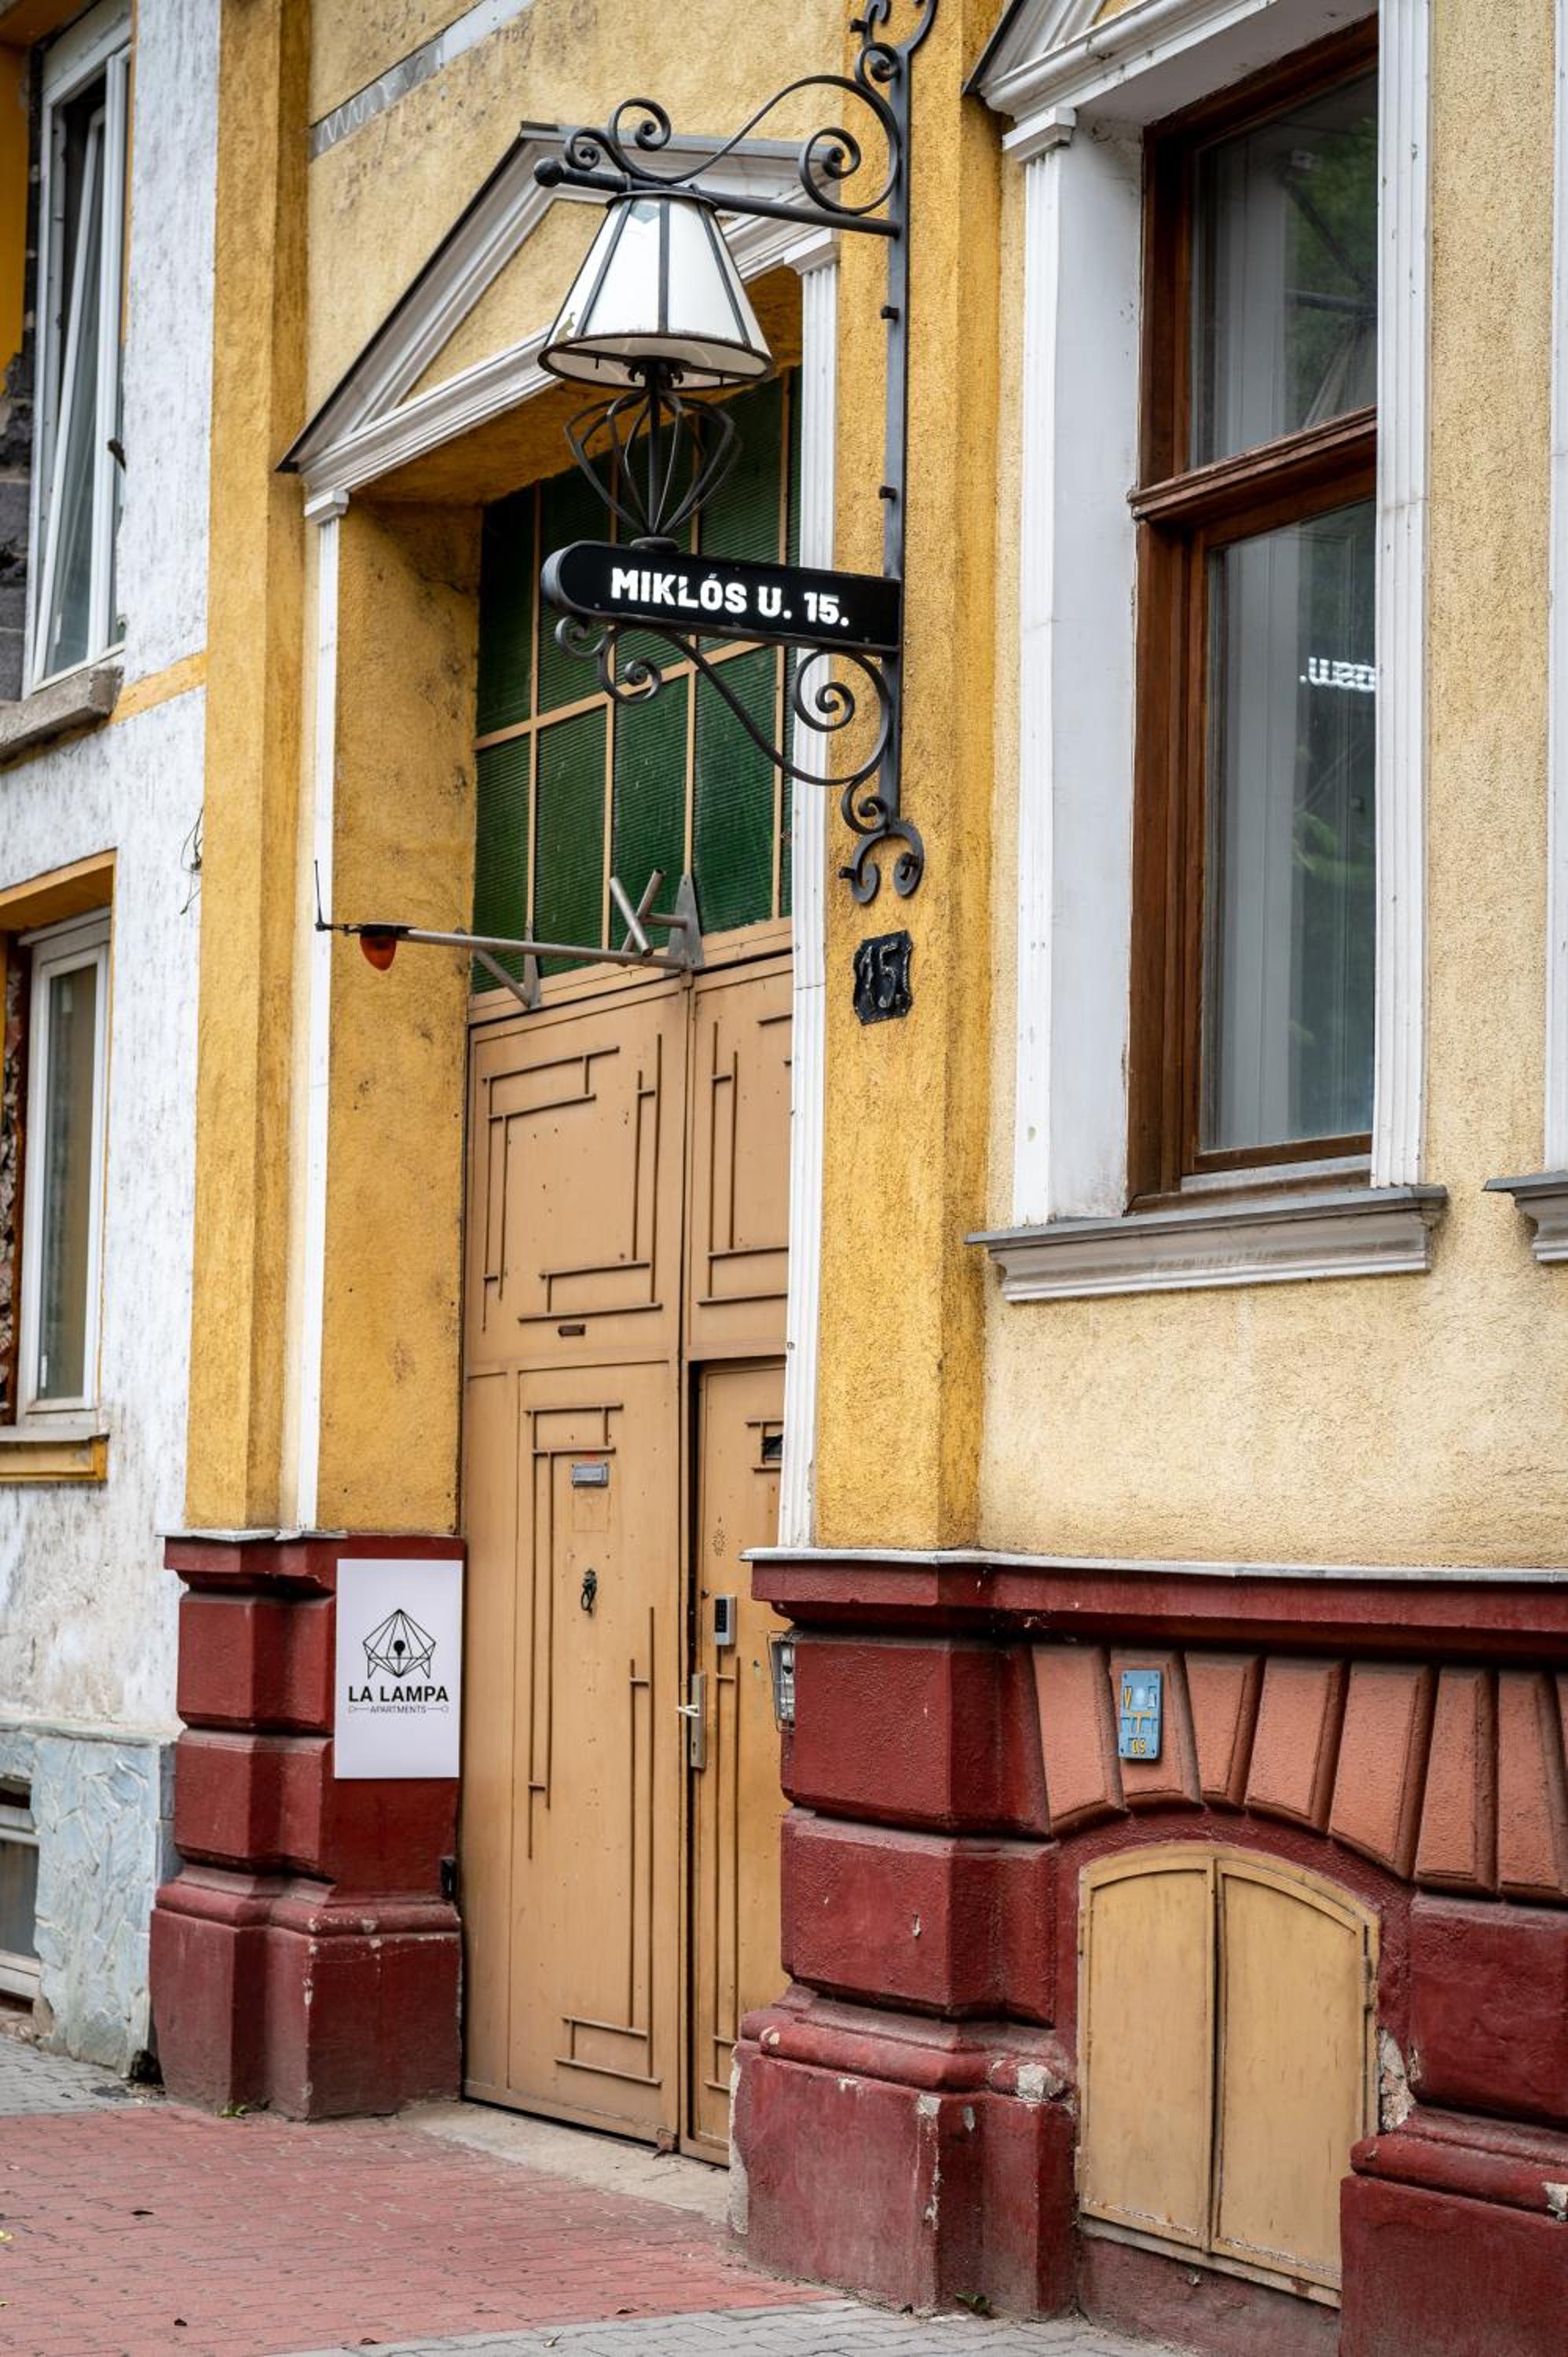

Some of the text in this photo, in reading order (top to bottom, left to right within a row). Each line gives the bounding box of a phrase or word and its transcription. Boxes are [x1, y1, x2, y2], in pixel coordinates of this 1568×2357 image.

[610, 566, 849, 627] MIKLÓS U. 15.
[348, 1685, 449, 1703] LA LAMPA
[369, 1704, 427, 1714] APARTMENTS
